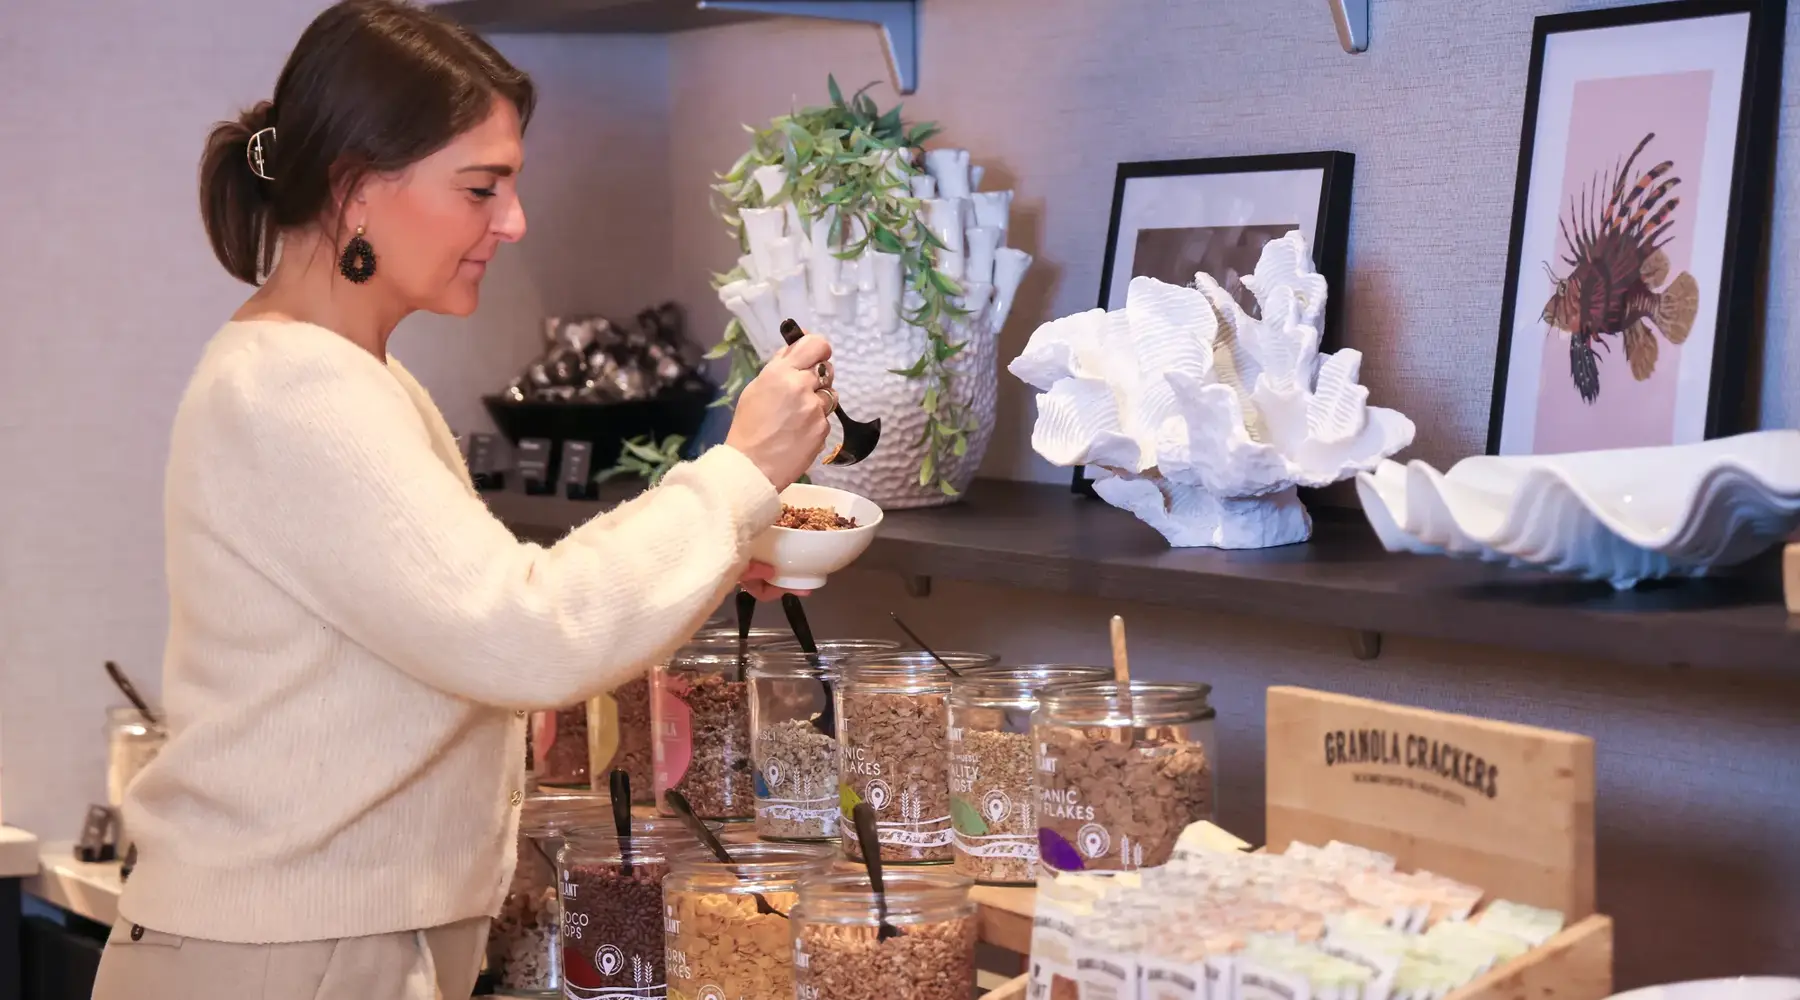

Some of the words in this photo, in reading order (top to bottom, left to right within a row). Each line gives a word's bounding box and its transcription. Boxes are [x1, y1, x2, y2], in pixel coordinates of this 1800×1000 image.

[1325, 729, 1401, 766] GRANOLA
[1405, 733, 1498, 799] CRACKERS
[1044, 802, 1095, 821] FLAKES
